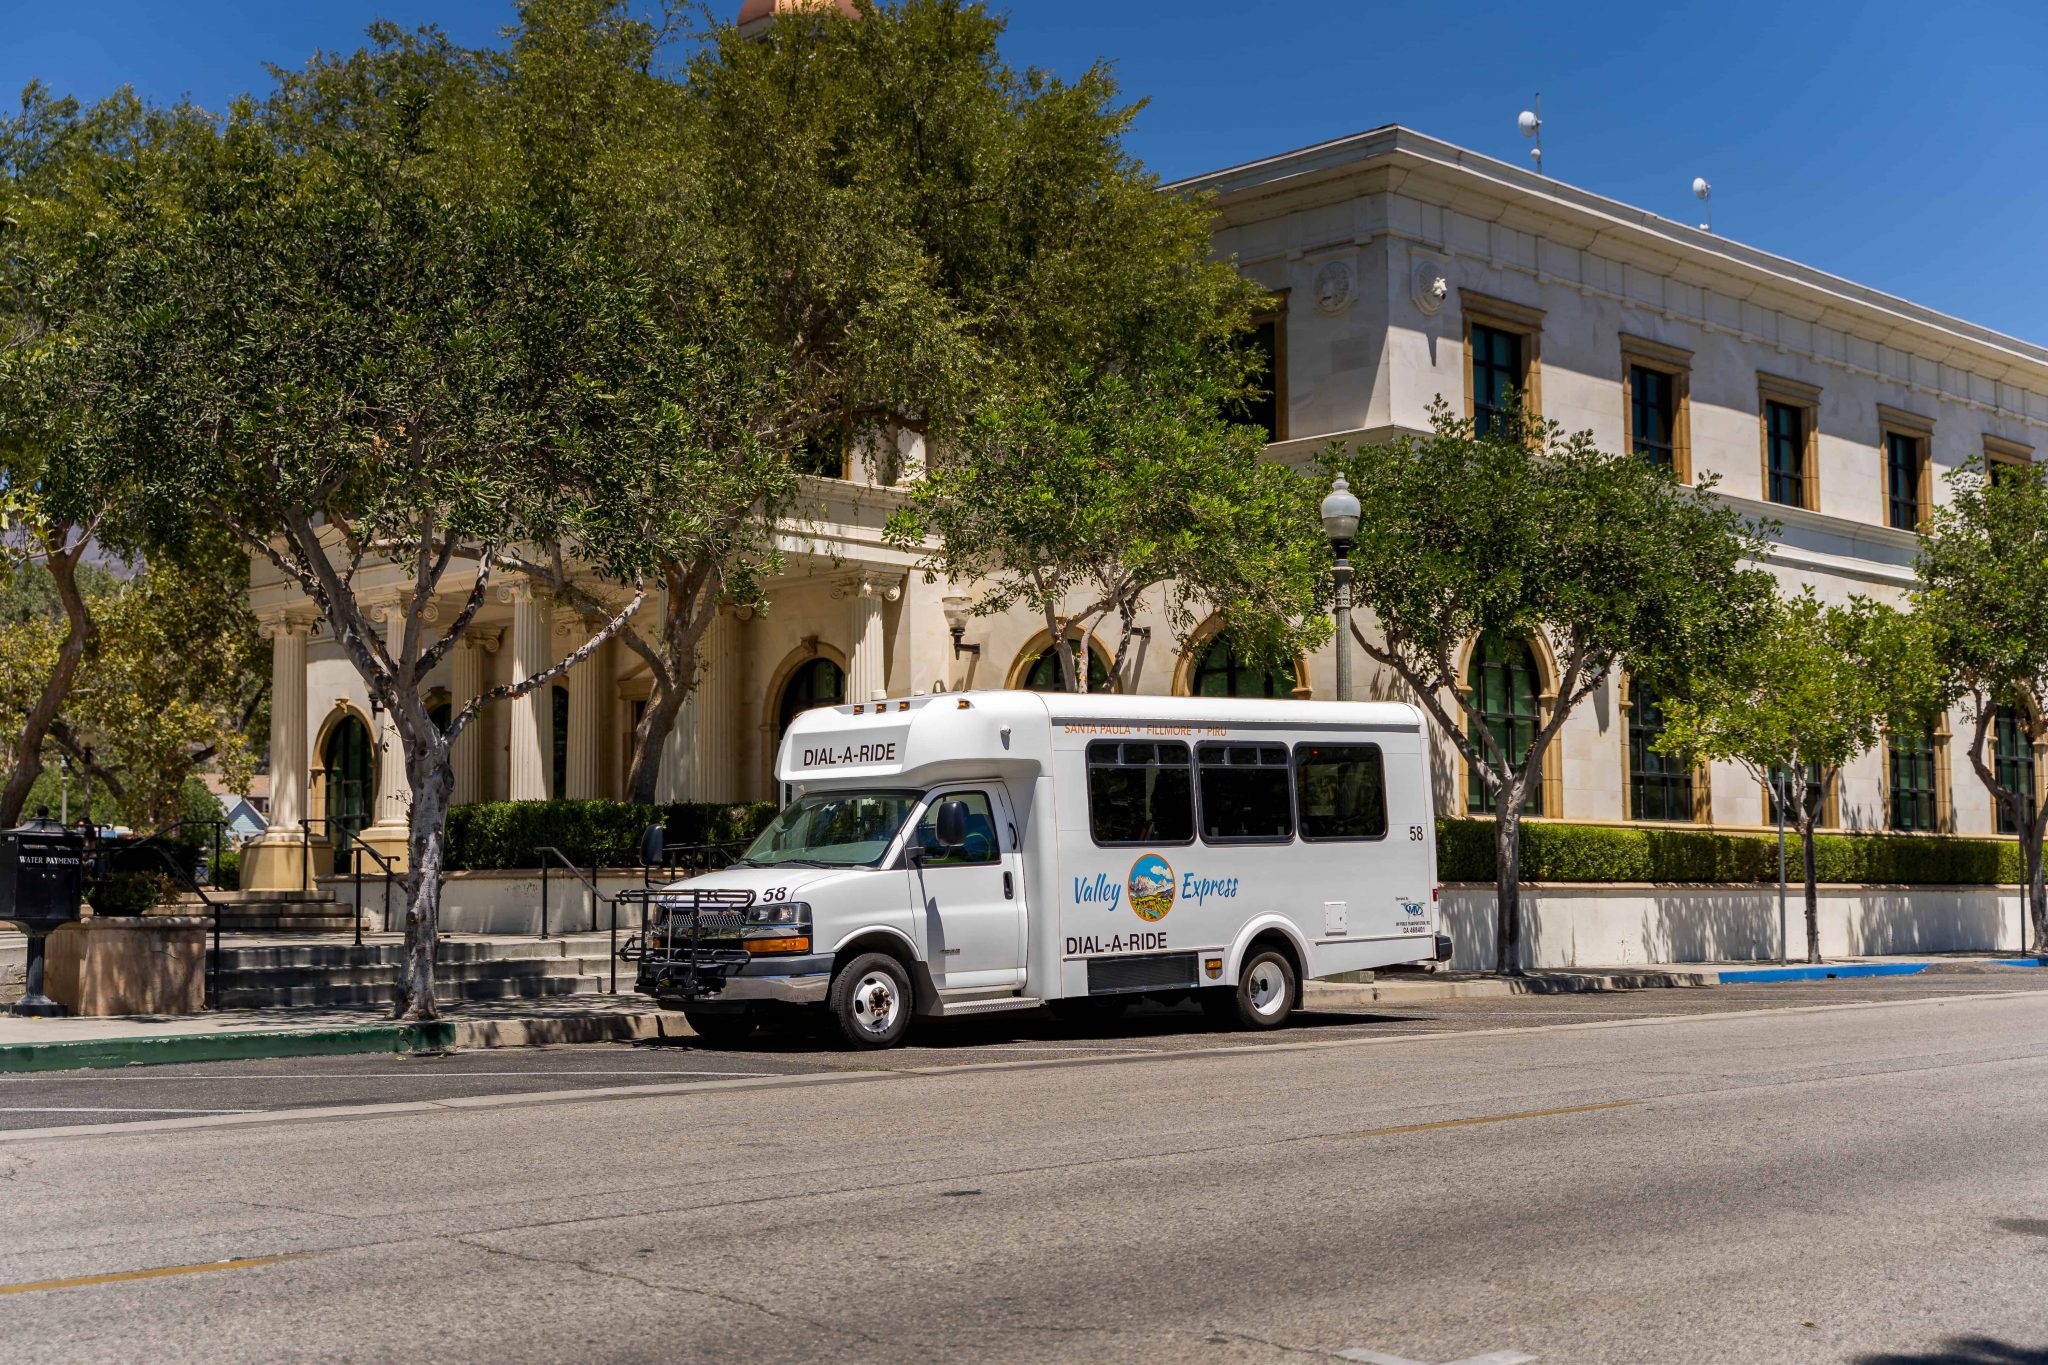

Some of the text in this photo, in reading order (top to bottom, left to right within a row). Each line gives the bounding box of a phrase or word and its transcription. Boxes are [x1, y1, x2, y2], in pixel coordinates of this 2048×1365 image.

[1064, 723, 1227, 737] SANTA PAULA FILLMORE PIRU
[803, 743, 896, 766] DIAL-A-RIDE
[1409, 826, 1423, 841] 58
[19, 855, 80, 865] WATER PAYMENTS
[763, 886, 787, 903] 58
[1074, 872, 1239, 912] Valley Express
[1066, 932, 1167, 954] DIAL-A-RIDE
